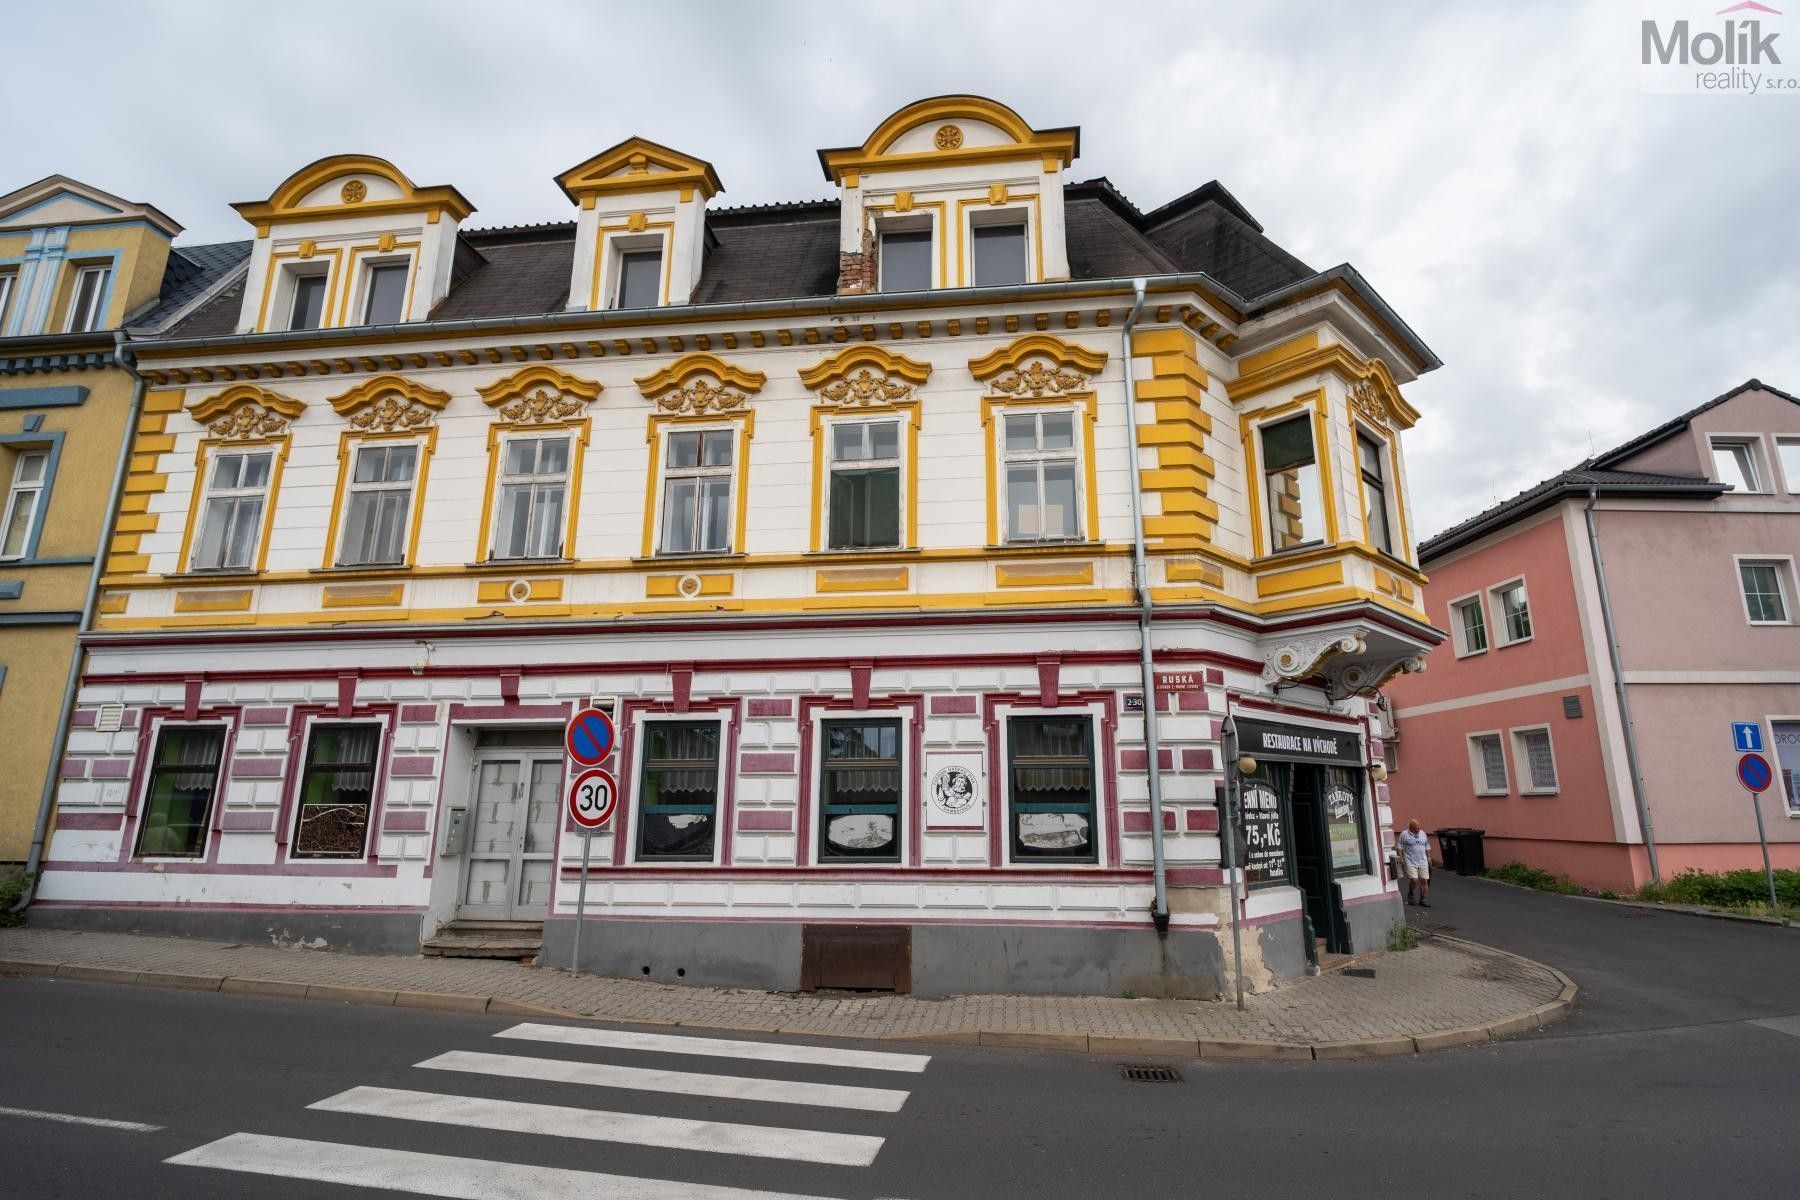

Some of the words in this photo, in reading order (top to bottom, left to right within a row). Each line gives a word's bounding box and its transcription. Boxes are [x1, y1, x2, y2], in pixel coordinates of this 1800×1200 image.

[1162, 673, 1194, 684] RUSKÁ
[1262, 732, 1301, 751] RESTAURACE
[1302, 737, 1312, 752] NA
[1312, 735, 1338, 755] VÝCHODĚ
[580, 784, 608, 811] 30
[1243, 784, 1258, 809] ENNÍ
[1259, 789, 1277, 809] MENU
